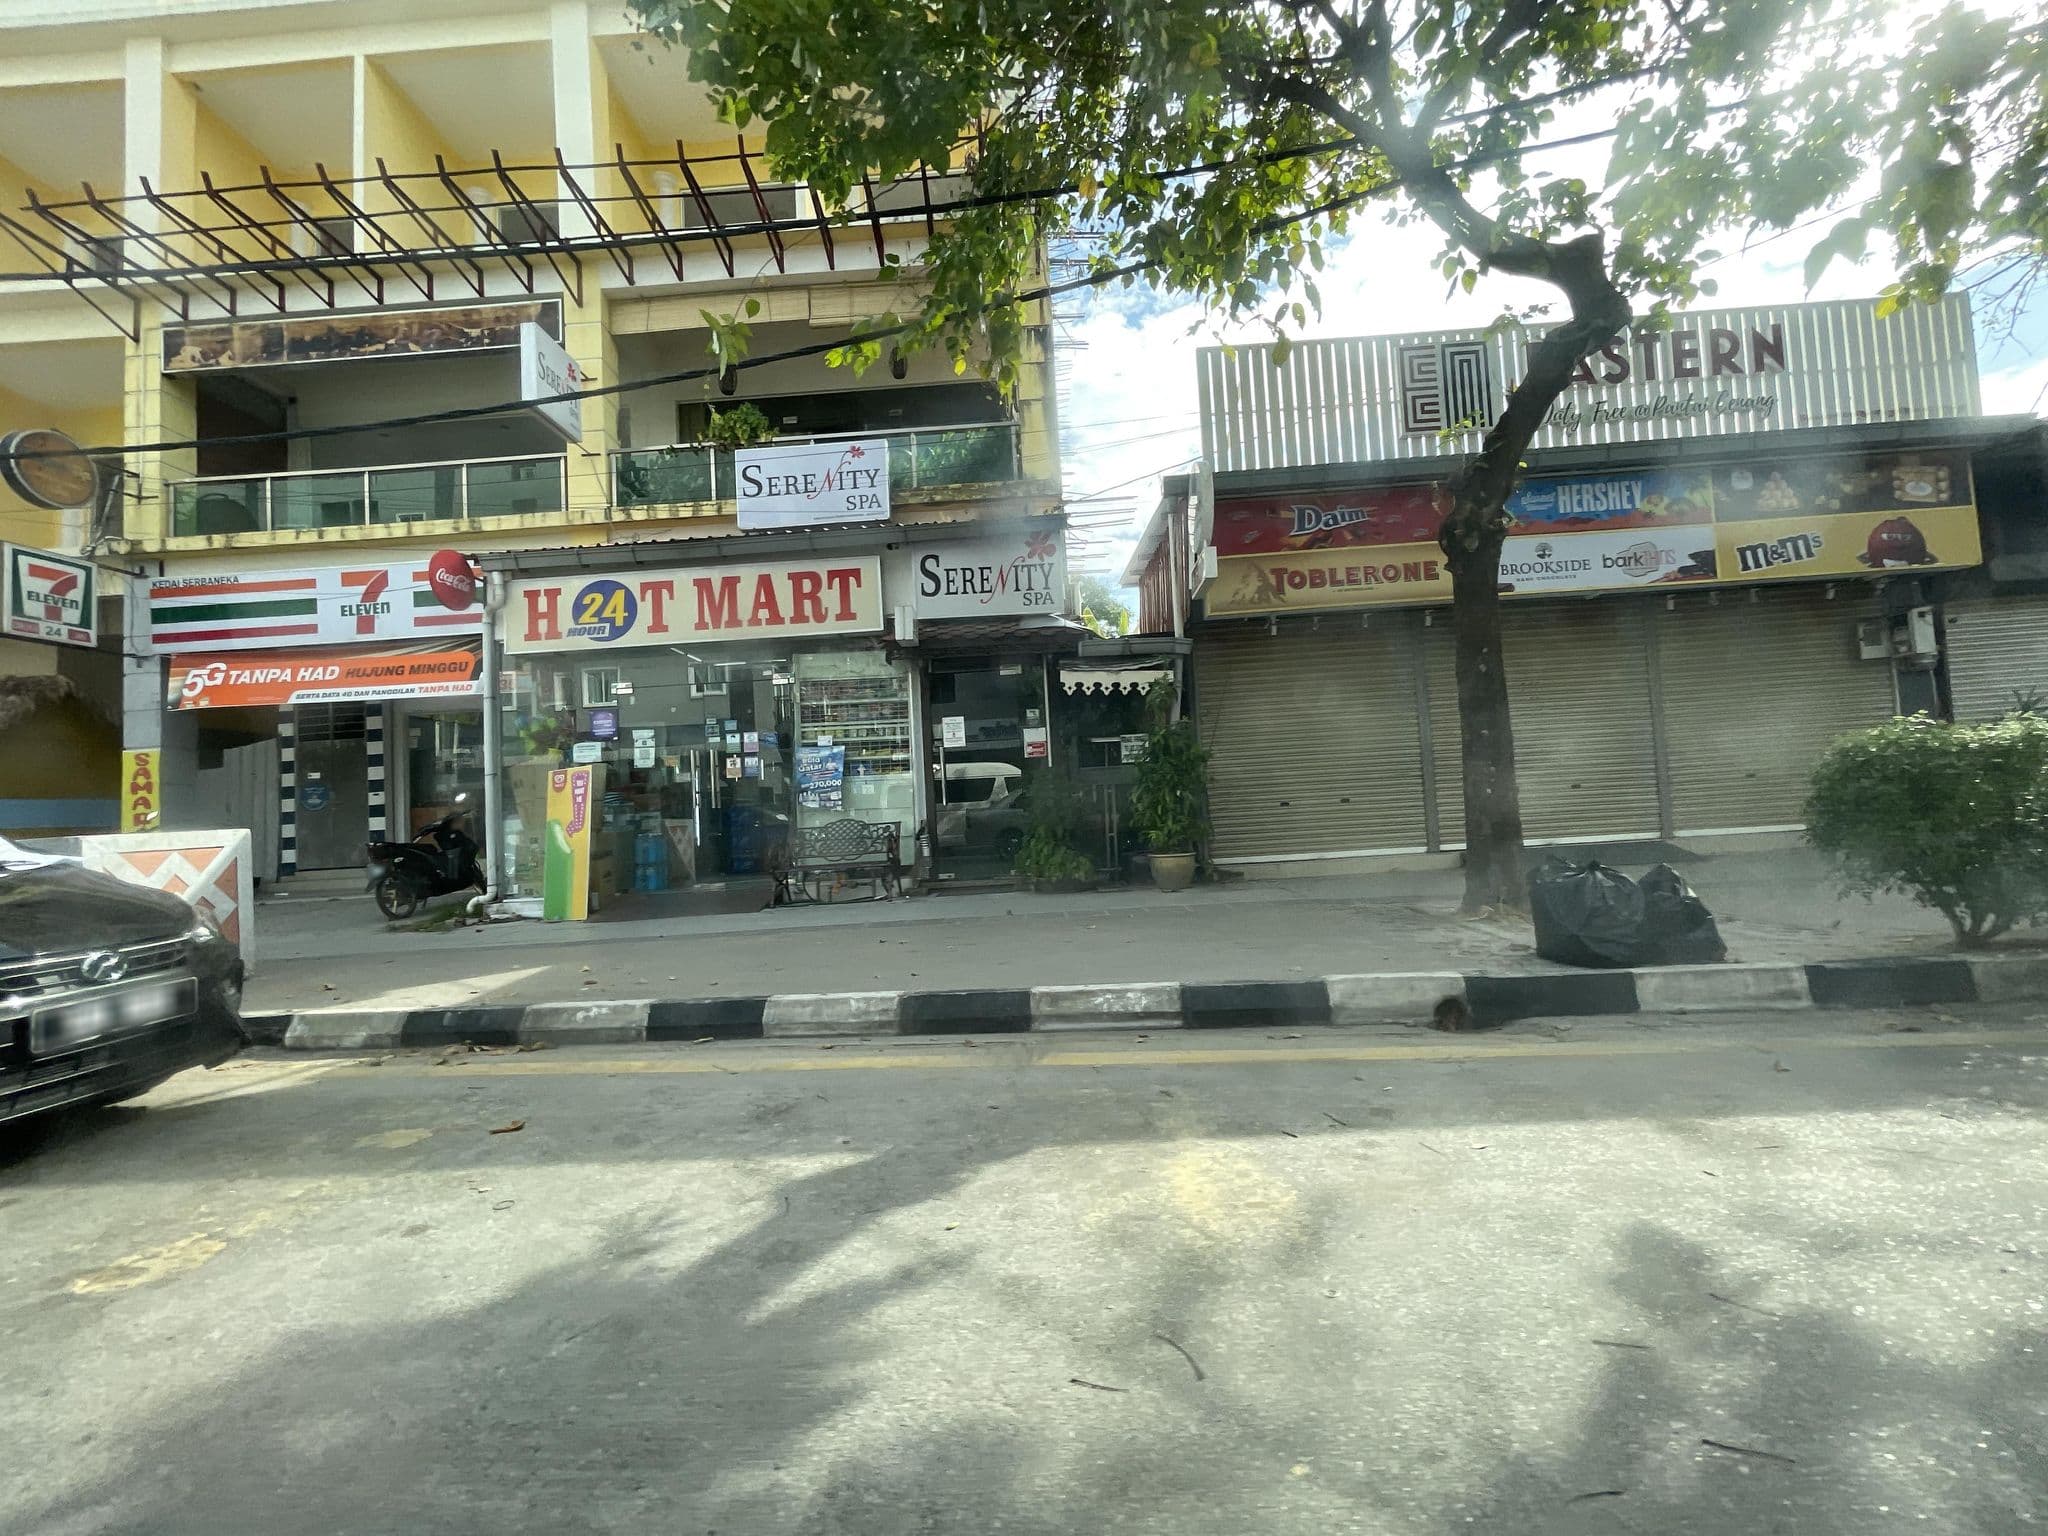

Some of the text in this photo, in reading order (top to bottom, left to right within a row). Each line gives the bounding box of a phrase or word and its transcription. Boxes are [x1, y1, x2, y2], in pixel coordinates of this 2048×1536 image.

[1526, 324, 1786, 386] ASTERN
[1593, 401, 1626, 422] Free
[741, 460, 880, 500] SERENITY
[846, 493, 882, 511] SPA
[1289, 504, 1368, 536] Daim
[920, 554, 1055, 604] SERENITY
[1270, 561, 1440, 595] TOBLERONE
[1500, 559, 1592, 575] BROOKSIDE
[152, 575, 240, 589] KEDAI SERBANEKA
[578, 588, 629, 627] 24
[692, 567, 862, 631] MART
[1023, 592, 1055, 607] SPA
[44, 626, 62, 636] 24
[566, 625, 607, 638] HOUR
[182, 661, 469, 697] 5G TANPA HAD HUJUNG MINGGU
[417, 684, 450, 694] TANPA
[452, 683, 473, 692] HAD
